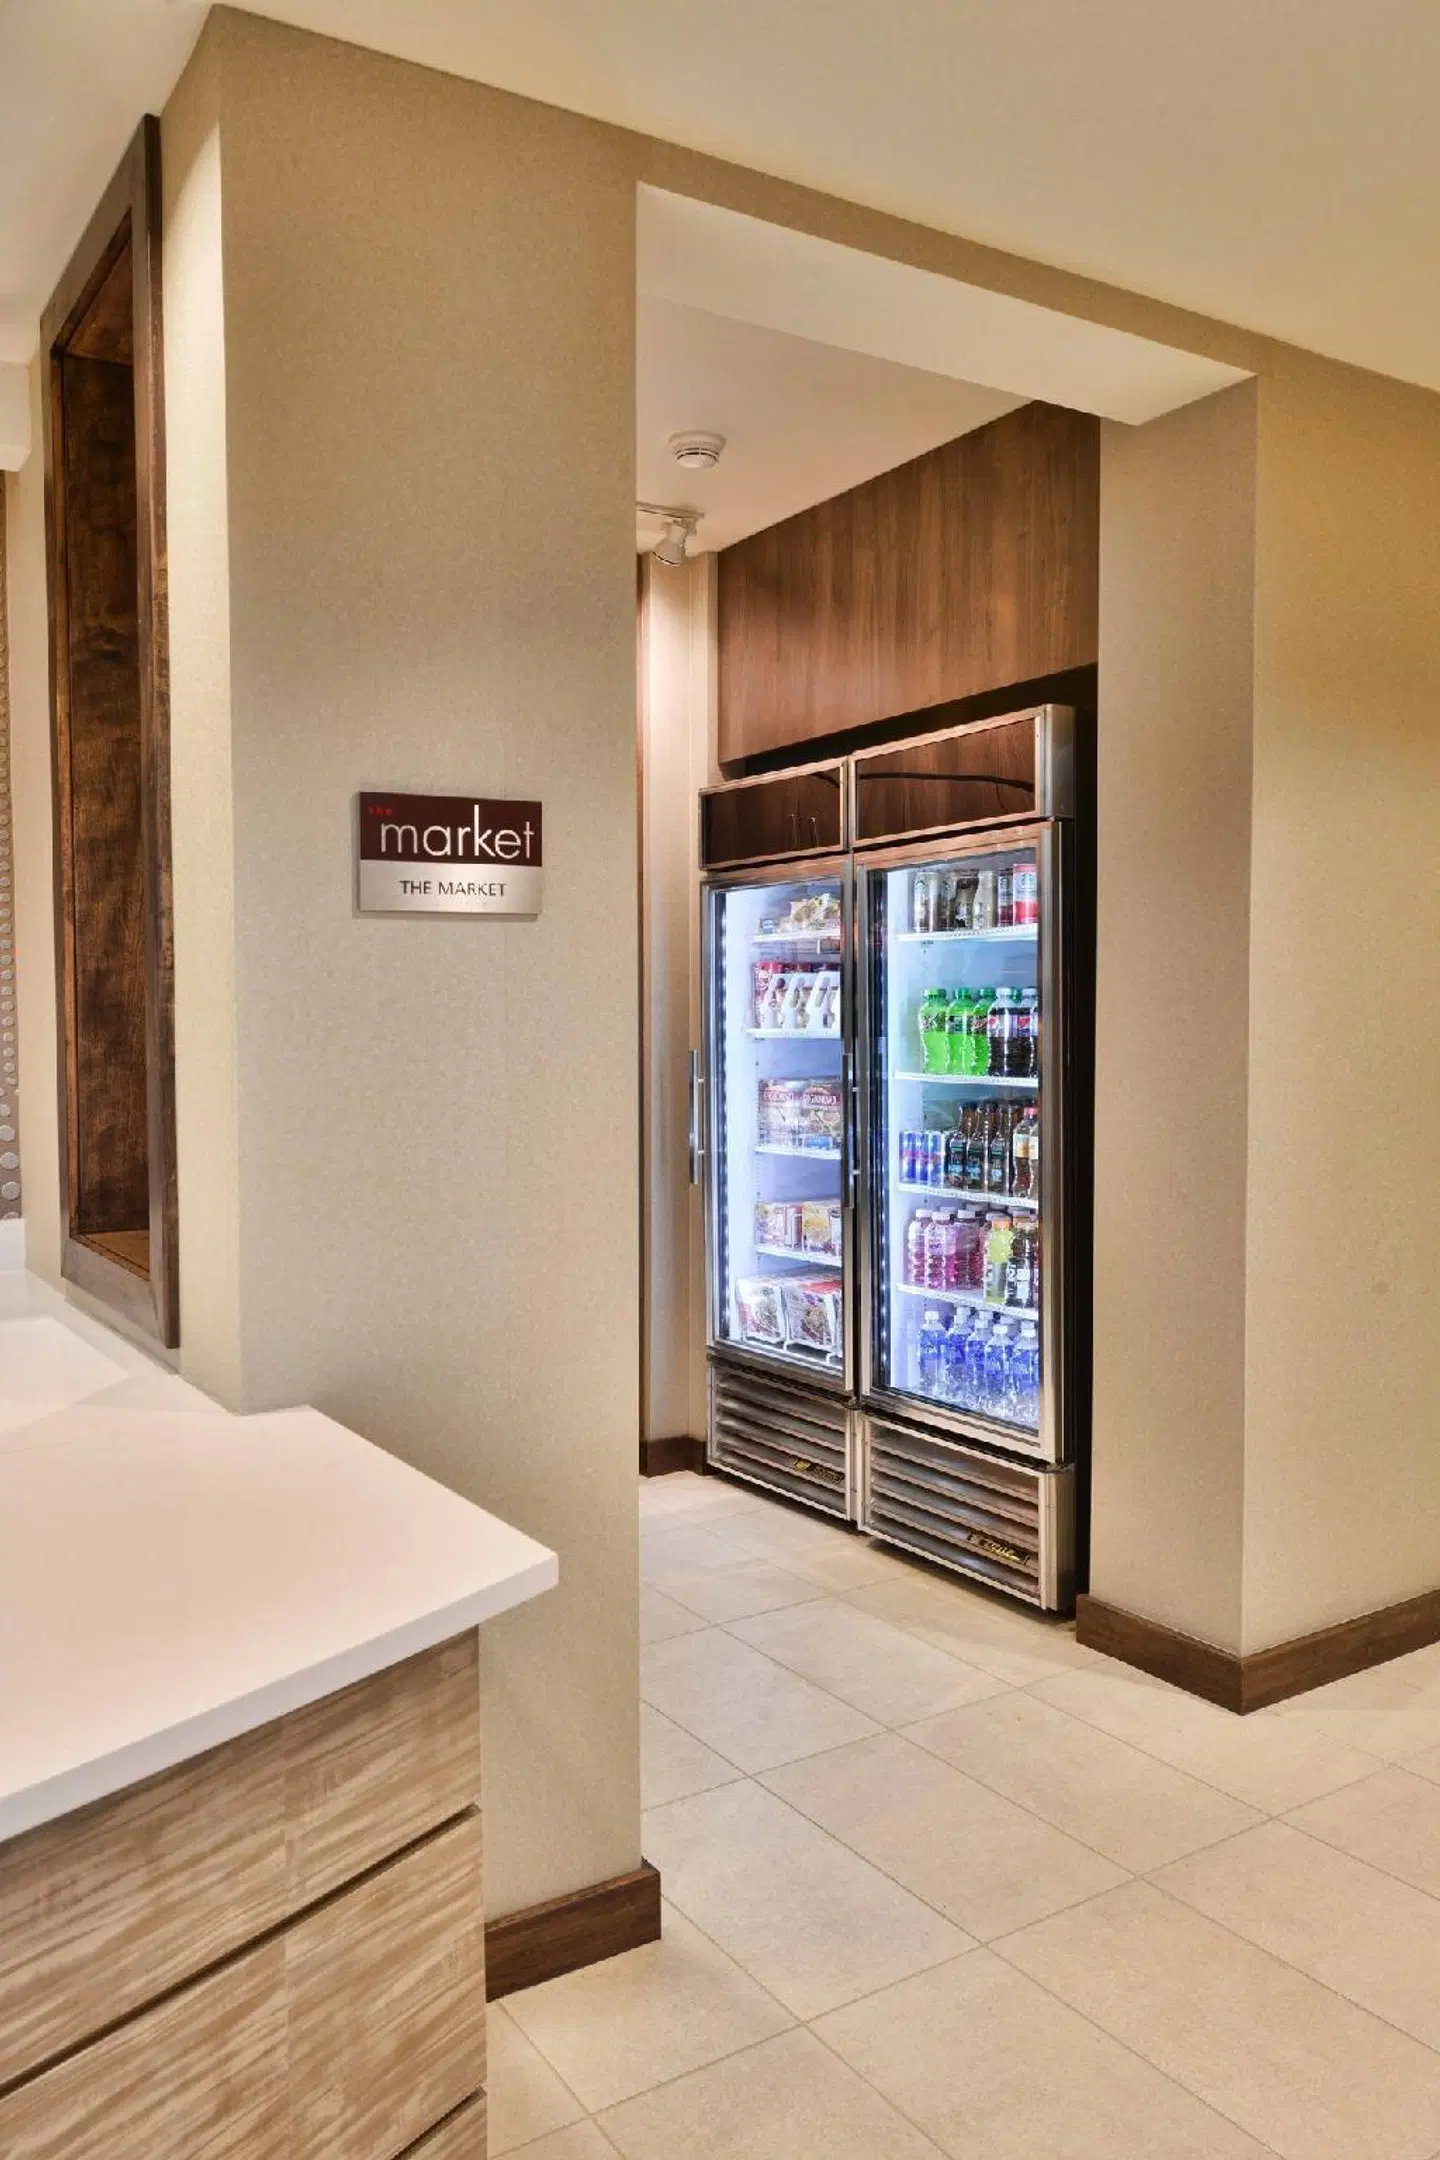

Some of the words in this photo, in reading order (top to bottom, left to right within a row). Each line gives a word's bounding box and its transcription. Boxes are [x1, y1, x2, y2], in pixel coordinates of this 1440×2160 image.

[381, 804, 535, 859] market
[399, 880, 432, 895] THE
[438, 881, 507, 897] MARKET
